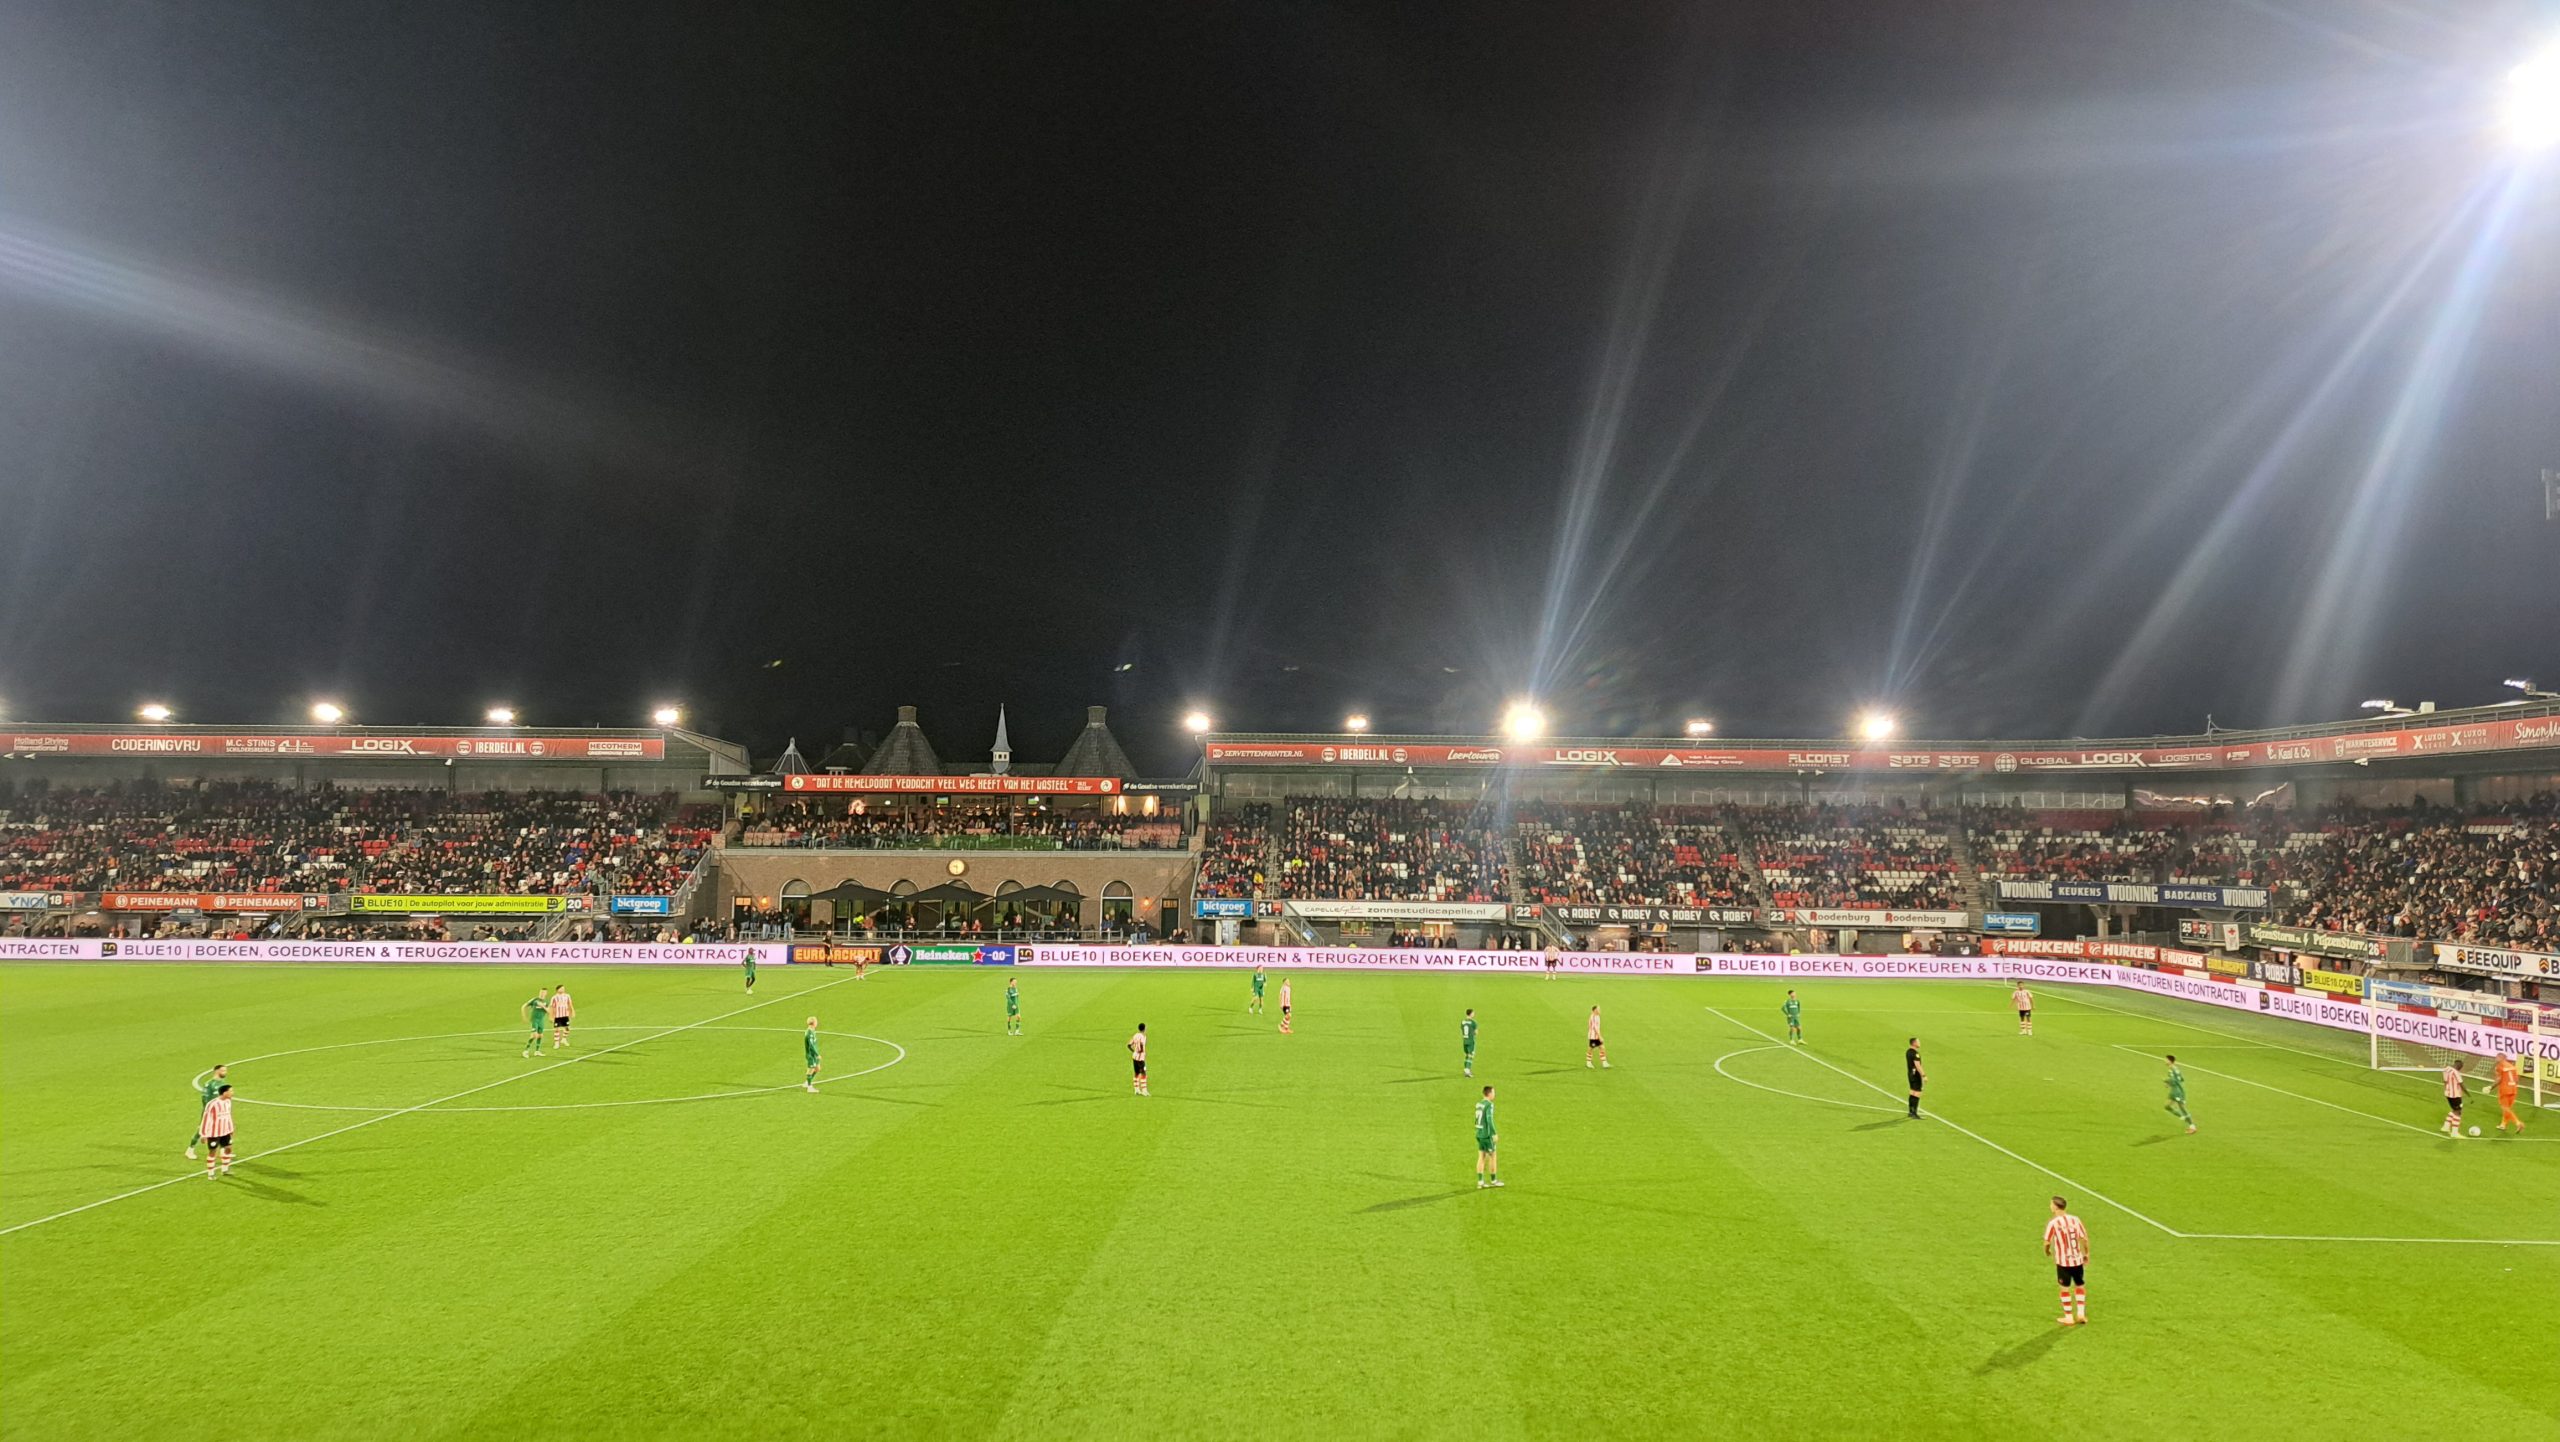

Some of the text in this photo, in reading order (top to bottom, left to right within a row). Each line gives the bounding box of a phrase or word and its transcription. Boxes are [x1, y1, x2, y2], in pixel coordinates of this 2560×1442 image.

[2424, 733, 2446, 742] LUXOR
[2463, 729, 2487, 738] LUXOR
[226, 739, 276, 747] M.C. STINIS
[351, 739, 415, 753] LOGIX
[2345, 736, 2398, 748] WARMTESERVICE
[475, 742, 527, 755] IBERDELI.NL
[1224, 750, 1304, 758] SERVETTENPRINTER.NL
[1340, 749, 1389, 760] IBERDELI.NL
[1556, 750, 1620, 765] LOGIX
[1902, 755, 1931, 765] BTS
[1951, 755, 1980, 765] BTS
[2020, 752, 2213, 769] GLOBAL LOGIX LOGISTICS
[712, 779, 782, 788] de Goudse verzekeringen
[833, 778, 844, 789] DE
[895, 778, 935, 790] VERDACHT
[937, 778, 957, 790] VEEL
[959, 778, 977, 790] WEG
[978, 779, 1000, 790] HEEFT
[1002, 779, 1019, 790] VAN
[1021, 779, 1036, 790] HET
[1158, 783, 1198, 791] verzekeringen
[49, 895, 62, 905] 18
[2000, 881, 2053, 899] WOONING
[2058, 886, 2102, 897] KEUKENS
[2107, 884, 2158, 903] WOONING
[2222, 888, 2268, 908] WOONING
[130, 897, 198, 906] PEINEMANN
[228, 897, 298, 907] PEINEMANN
[304, 897, 317, 908] 19
[367, 899, 403, 908] BLUE10
[410, 899, 420, 908] De
[422, 899, 460, 910] autopilot
[474, 899, 494, 909] jouw
[495, 899, 544, 908] administratie
[567, 898, 582, 909] 20
[617, 898, 661, 910] bictgroep
[1203, 901, 1246, 914] bictgroep
[1258, 902, 1272, 914] 21
[1304, 906, 1340, 914] CAPELLE
[1367, 903, 1487, 917] zonnestudiocapelle.nl
[1516, 906, 1531, 917] 22
[1571, 908, 1601, 920] ROBEY
[1621, 908, 1652, 920] ROBEY
[1672, 909, 1702, 921] ROBEY
[1722, 910, 1752, 922] ROBEY
[1770, 911, 1785, 922] 23
[1810, 911, 1871, 923] Roodenburg
[1885, 912, 1947, 924] Roodenburg
[1987, 914, 2034, 928] bictgroep
[2182, 922, 2192, 934] 25
[2199, 923, 2208, 934] 25
[124, 945, 182, 956] BLUE10
[195, 945, 264, 959] BOEKEN,
[268, 946, 376, 957] GOEDKEUREN
[380, 946, 390, 957] &
[396, 946, 511, 959] TERUGZOEKEN
[515, 947, 546, 959] VAN
[551, 947, 633, 959] FACTUREN
[638, 948, 658, 959] EN
[2007, 940, 2085, 955] HURKENS
[2102, 943, 2156, 960] HURKENS
[2368, 942, 2380, 956] 26
[915, 949, 970, 962] Heineken
[1040, 950, 1098, 962] BLUE10
[1110, 951, 1177, 964] BOEKEN,
[1181, 951, 1288, 964] GOEDKEUREN
[1292, 952, 1302, 963] &
[1307, 952, 1419, 965] TERUGZOEKEN
[1425, 954, 1454, 966] VAN
[1458, 955, 1539, 967] FACTUREN
[1569, 956, 1674, 969] CONTRACTEN
[2167, 950, 2204, 968] HURKENS
[2467, 950, 2522, 971] BEEQUIP
[2264, 963, 2290, 983] ROBEY
[1718, 959, 1777, 971] BLUE10
[1789, 960, 1858, 974] BOEKEN,
[1862, 961, 1972, 974] GOEDKEUREN
[1977, 962, 1988, 974] &
[1993, 962, 2112, 981] TERUGZOEKEN
[2117, 970, 2132, 983] VAN
[2133, 972, 2173, 991] FACTUREN
[2174, 980, 2186, 994] EN
[2187, 982, 2247, 1004] CONTRACTEN
[2314, 975, 2354, 992] BLUE10.COM
[2273, 997, 2312, 1017] BLUE10
[2321, 1005, 2373, 1030] BOEKEN,
[2376, 1013, 2467, 1045] GOEDKEUREN
[2471, 1031, 2482, 1048] &
